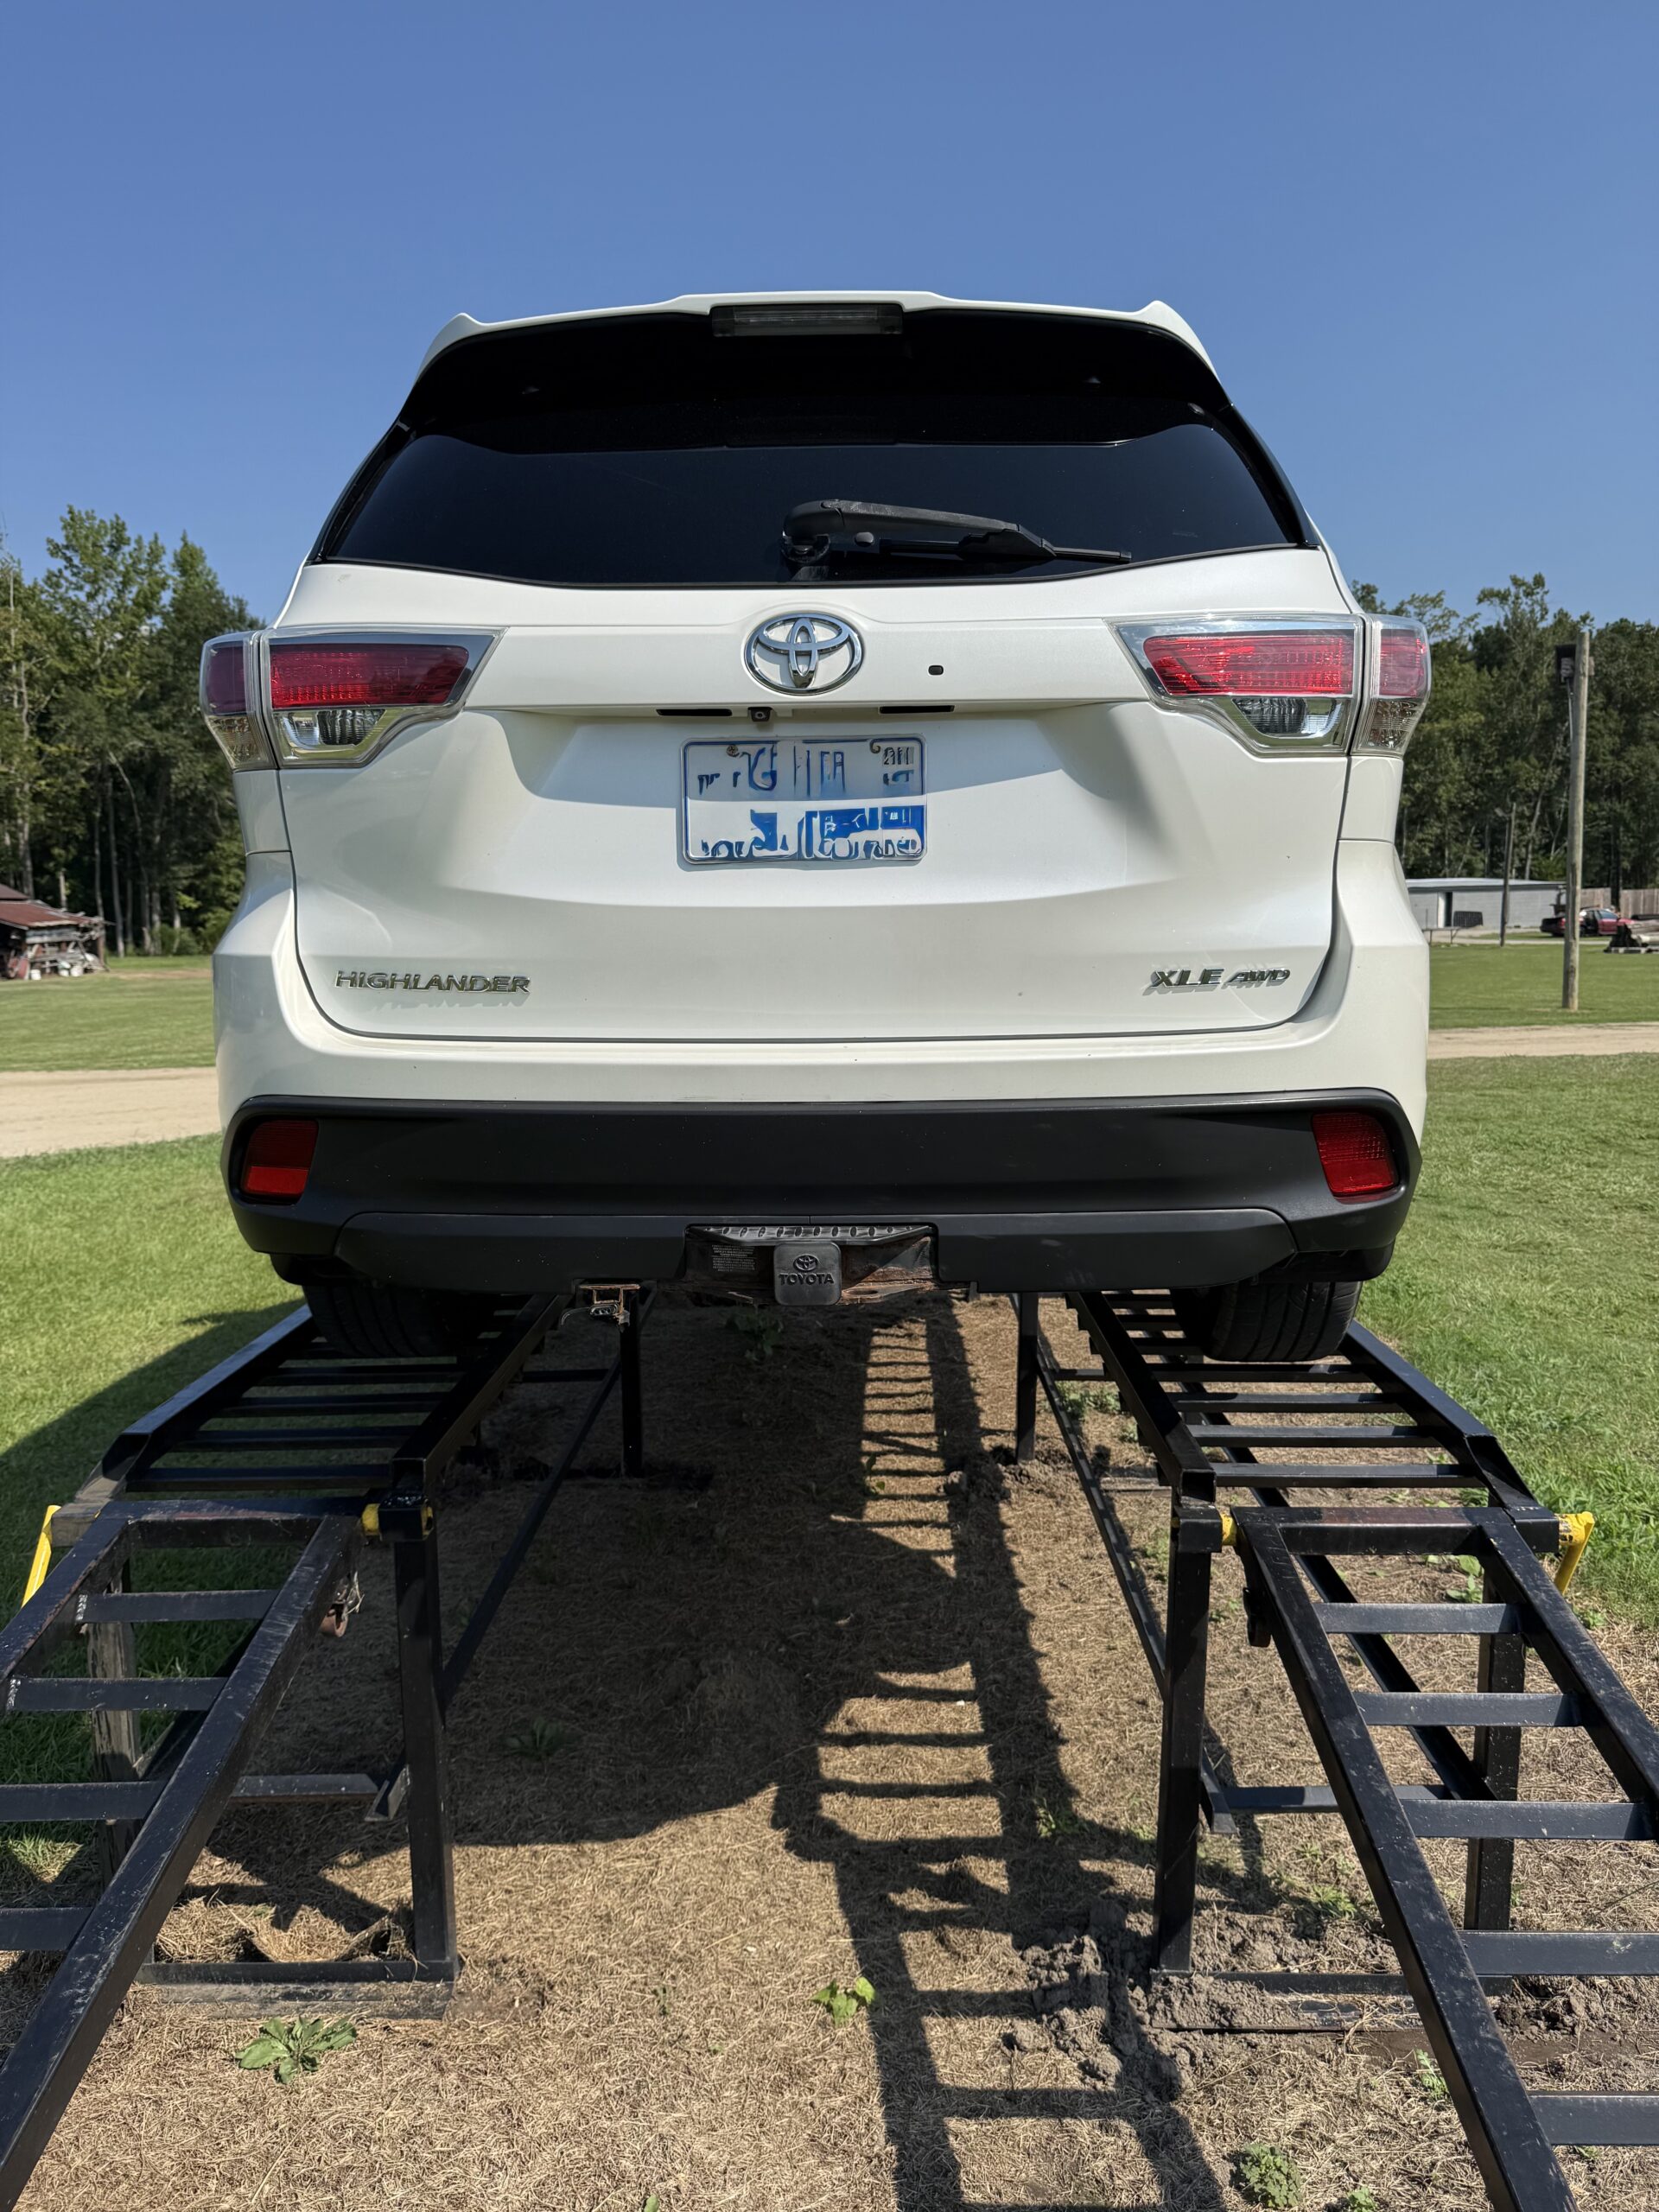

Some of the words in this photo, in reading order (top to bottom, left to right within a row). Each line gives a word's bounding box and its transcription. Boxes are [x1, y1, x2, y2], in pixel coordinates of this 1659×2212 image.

[335, 969, 531, 993] HIGHLANDER
[1151, 968, 1224, 987] XLE
[1226, 968, 1291, 983] AWD
[779, 1273, 835, 1286] TOYOTA
